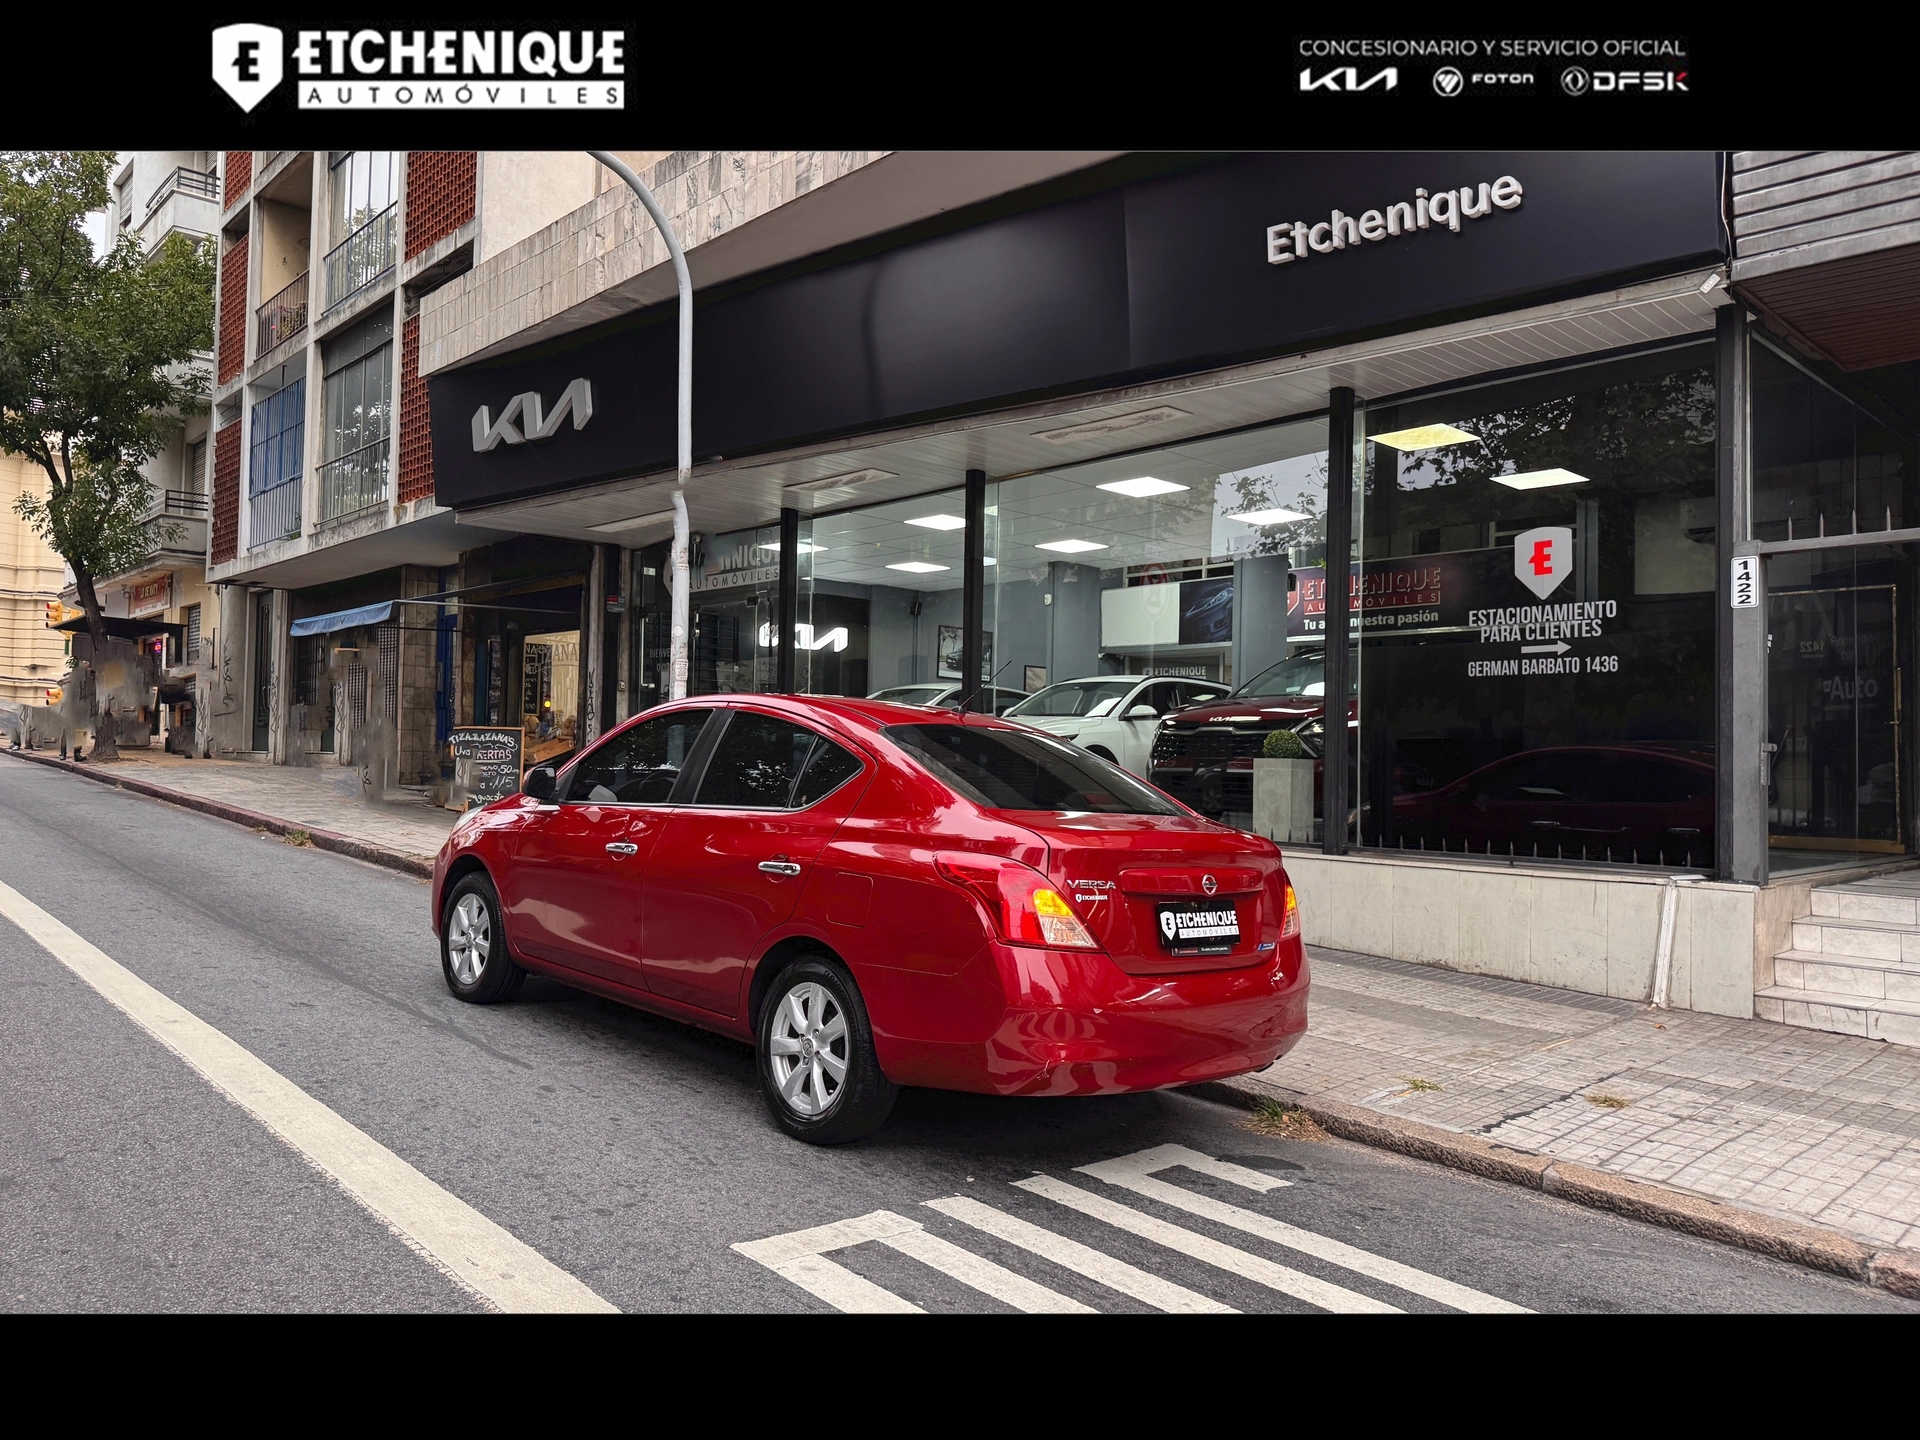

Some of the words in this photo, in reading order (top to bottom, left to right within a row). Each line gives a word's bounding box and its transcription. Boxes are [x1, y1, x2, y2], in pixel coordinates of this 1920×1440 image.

[1266, 175, 1523, 265] Etchenique
[471, 377, 593, 453] KIA
[1737, 560, 1752, 605] 1422
[1306, 593, 1436, 612] AUMÓVILES
[1468, 600, 1617, 627] ESTACIONAMIENTO
[1303, 619, 1317, 631] Tu
[1397, 609, 1439, 627] pasión
[1480, 625, 1521, 643] PARA
[1525, 619, 1602, 641] CLIENTES
[649, 648, 671, 659] BIENVE
[1468, 659, 1519, 677] GERMAN
[1521, 657, 1580, 675] BARBATO
[1585, 655, 1619, 673] 1436
[1066, 879, 1116, 889] VERSA
[1175, 910, 1238, 928] ETCHENIQUE
